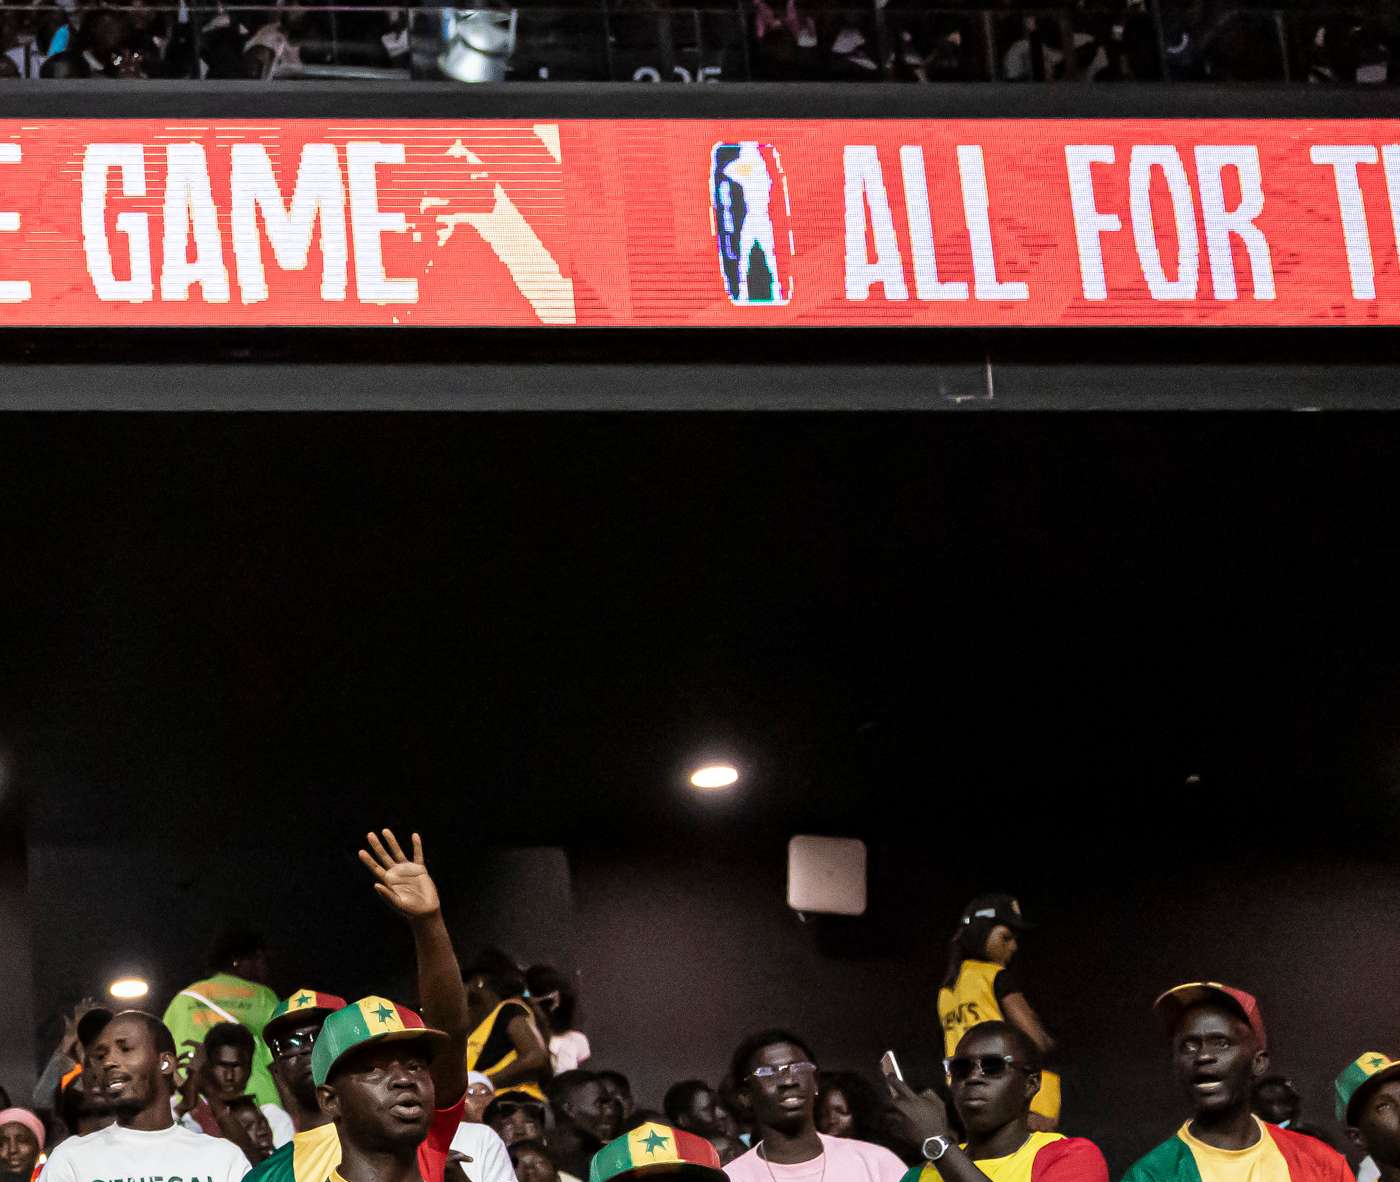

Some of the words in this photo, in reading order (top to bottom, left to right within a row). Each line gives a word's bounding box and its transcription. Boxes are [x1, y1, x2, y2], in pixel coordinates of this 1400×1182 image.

[80, 141, 419, 304] GAME
[843, 145, 1029, 300] ALL
[1064, 145, 1276, 301] FOR
